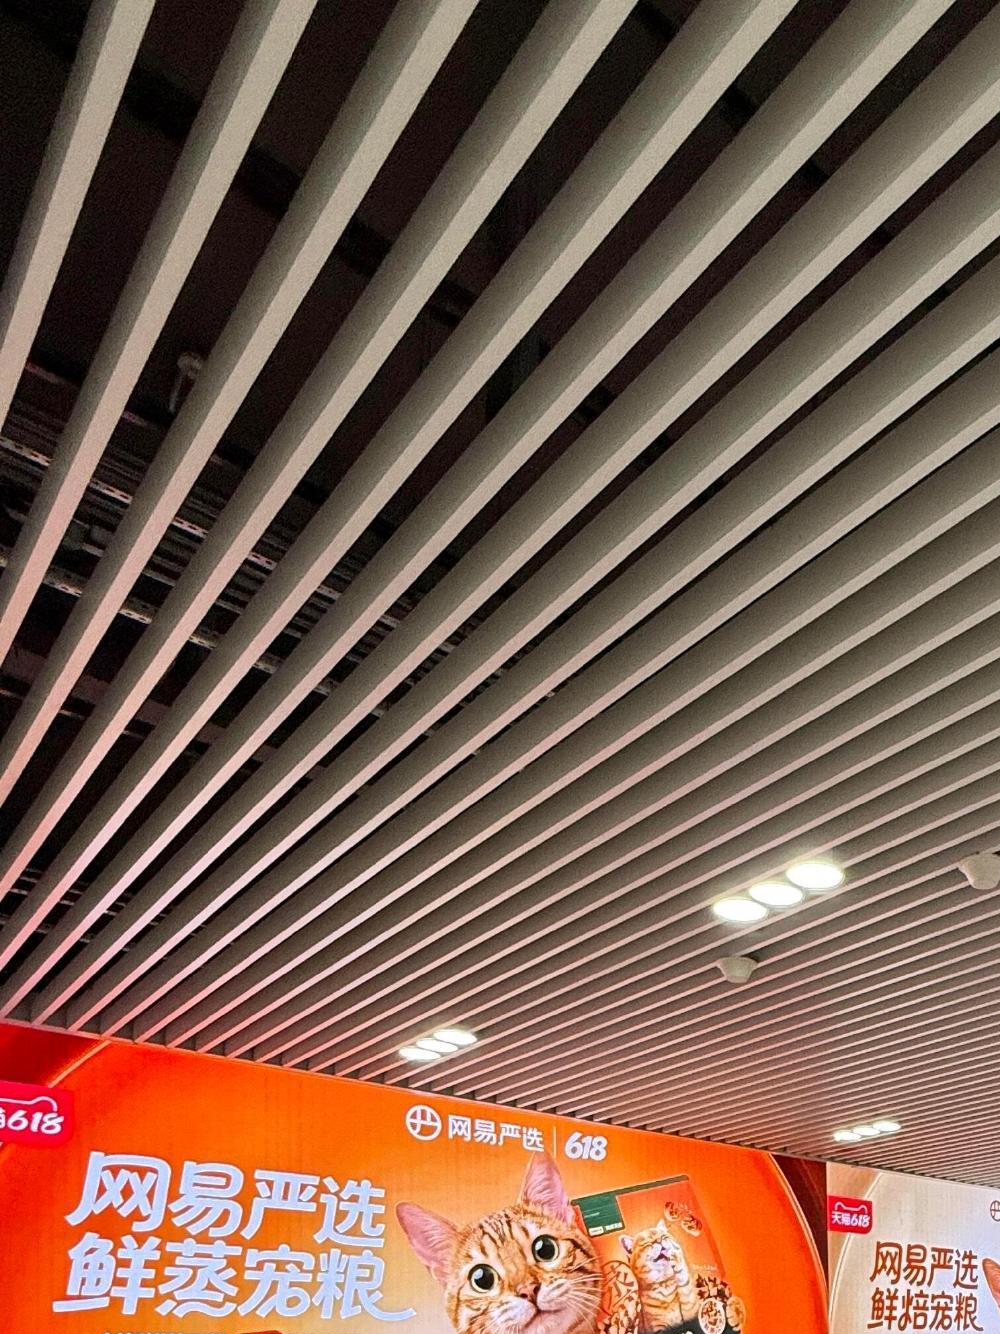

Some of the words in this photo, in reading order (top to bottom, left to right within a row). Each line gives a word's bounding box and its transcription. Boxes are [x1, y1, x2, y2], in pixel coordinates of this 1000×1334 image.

[448, 1115, 544, 1152] 网易严选
[565, 1131, 608, 1161] 618
[65, 1151, 385, 1248] 网易严选
[832, 1211, 870, 1228] 天猫618
[53, 1232, 416, 1321] 鲜蒸宠粮
[870, 1241, 978, 1290] 网易严选
[867, 1287, 984, 1331] 鲜焙宠粮
